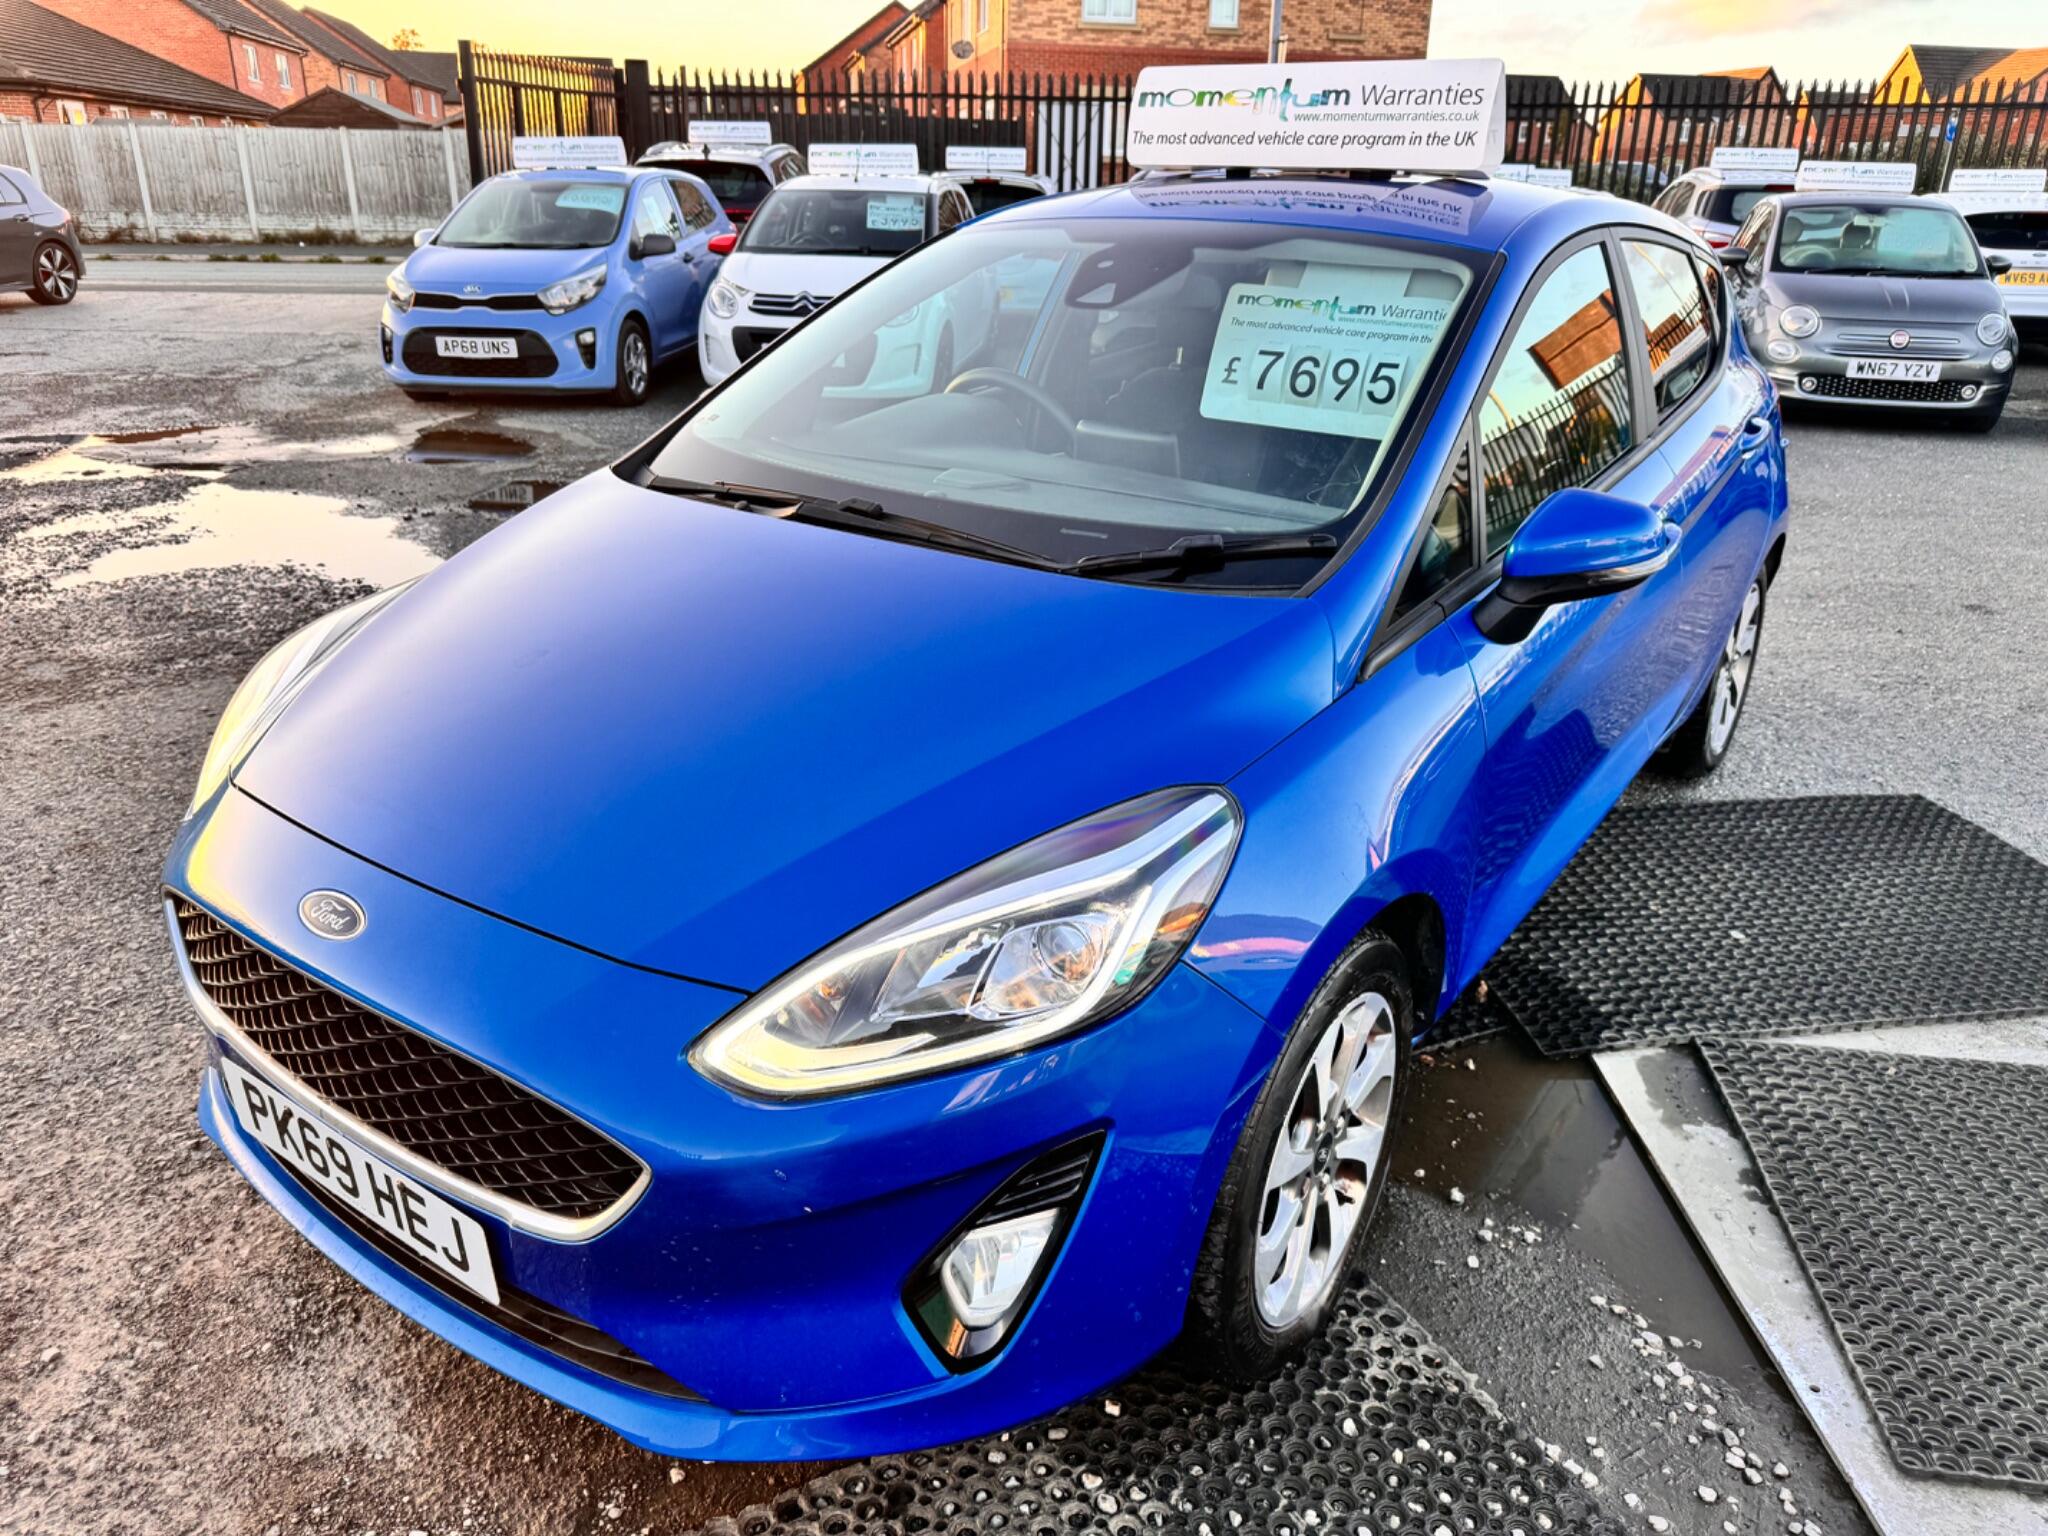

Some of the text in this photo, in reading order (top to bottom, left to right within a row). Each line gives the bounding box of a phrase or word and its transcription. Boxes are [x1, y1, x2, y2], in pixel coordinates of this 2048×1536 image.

[1138, 78, 1485, 122] momentum Warranties
[1294, 110, 1480, 123] www.momentumwarranties.co.uk
[1133, 131, 1479, 149] The most advanced vehicle care program in the UK
[2039, 272, 2048, 284] A
[1237, 294, 1377, 322] momentum
[1231, 316, 1245, 327] The
[1246, 319, 1267, 329] most
[1268, 321, 1313, 333] advanced
[1313, 325, 1344, 336] vehicle
[1345, 328, 1366, 338] care
[1366, 330, 1409, 343] program
[1409, 331, 1419, 343] in
[443, 339, 510, 355] AP68 UNS
[1856, 361, 1935, 378] WN67 YZV
[311, 899, 351, 931] Ford
[241, 1077, 470, 1273] PK69 HEJ
